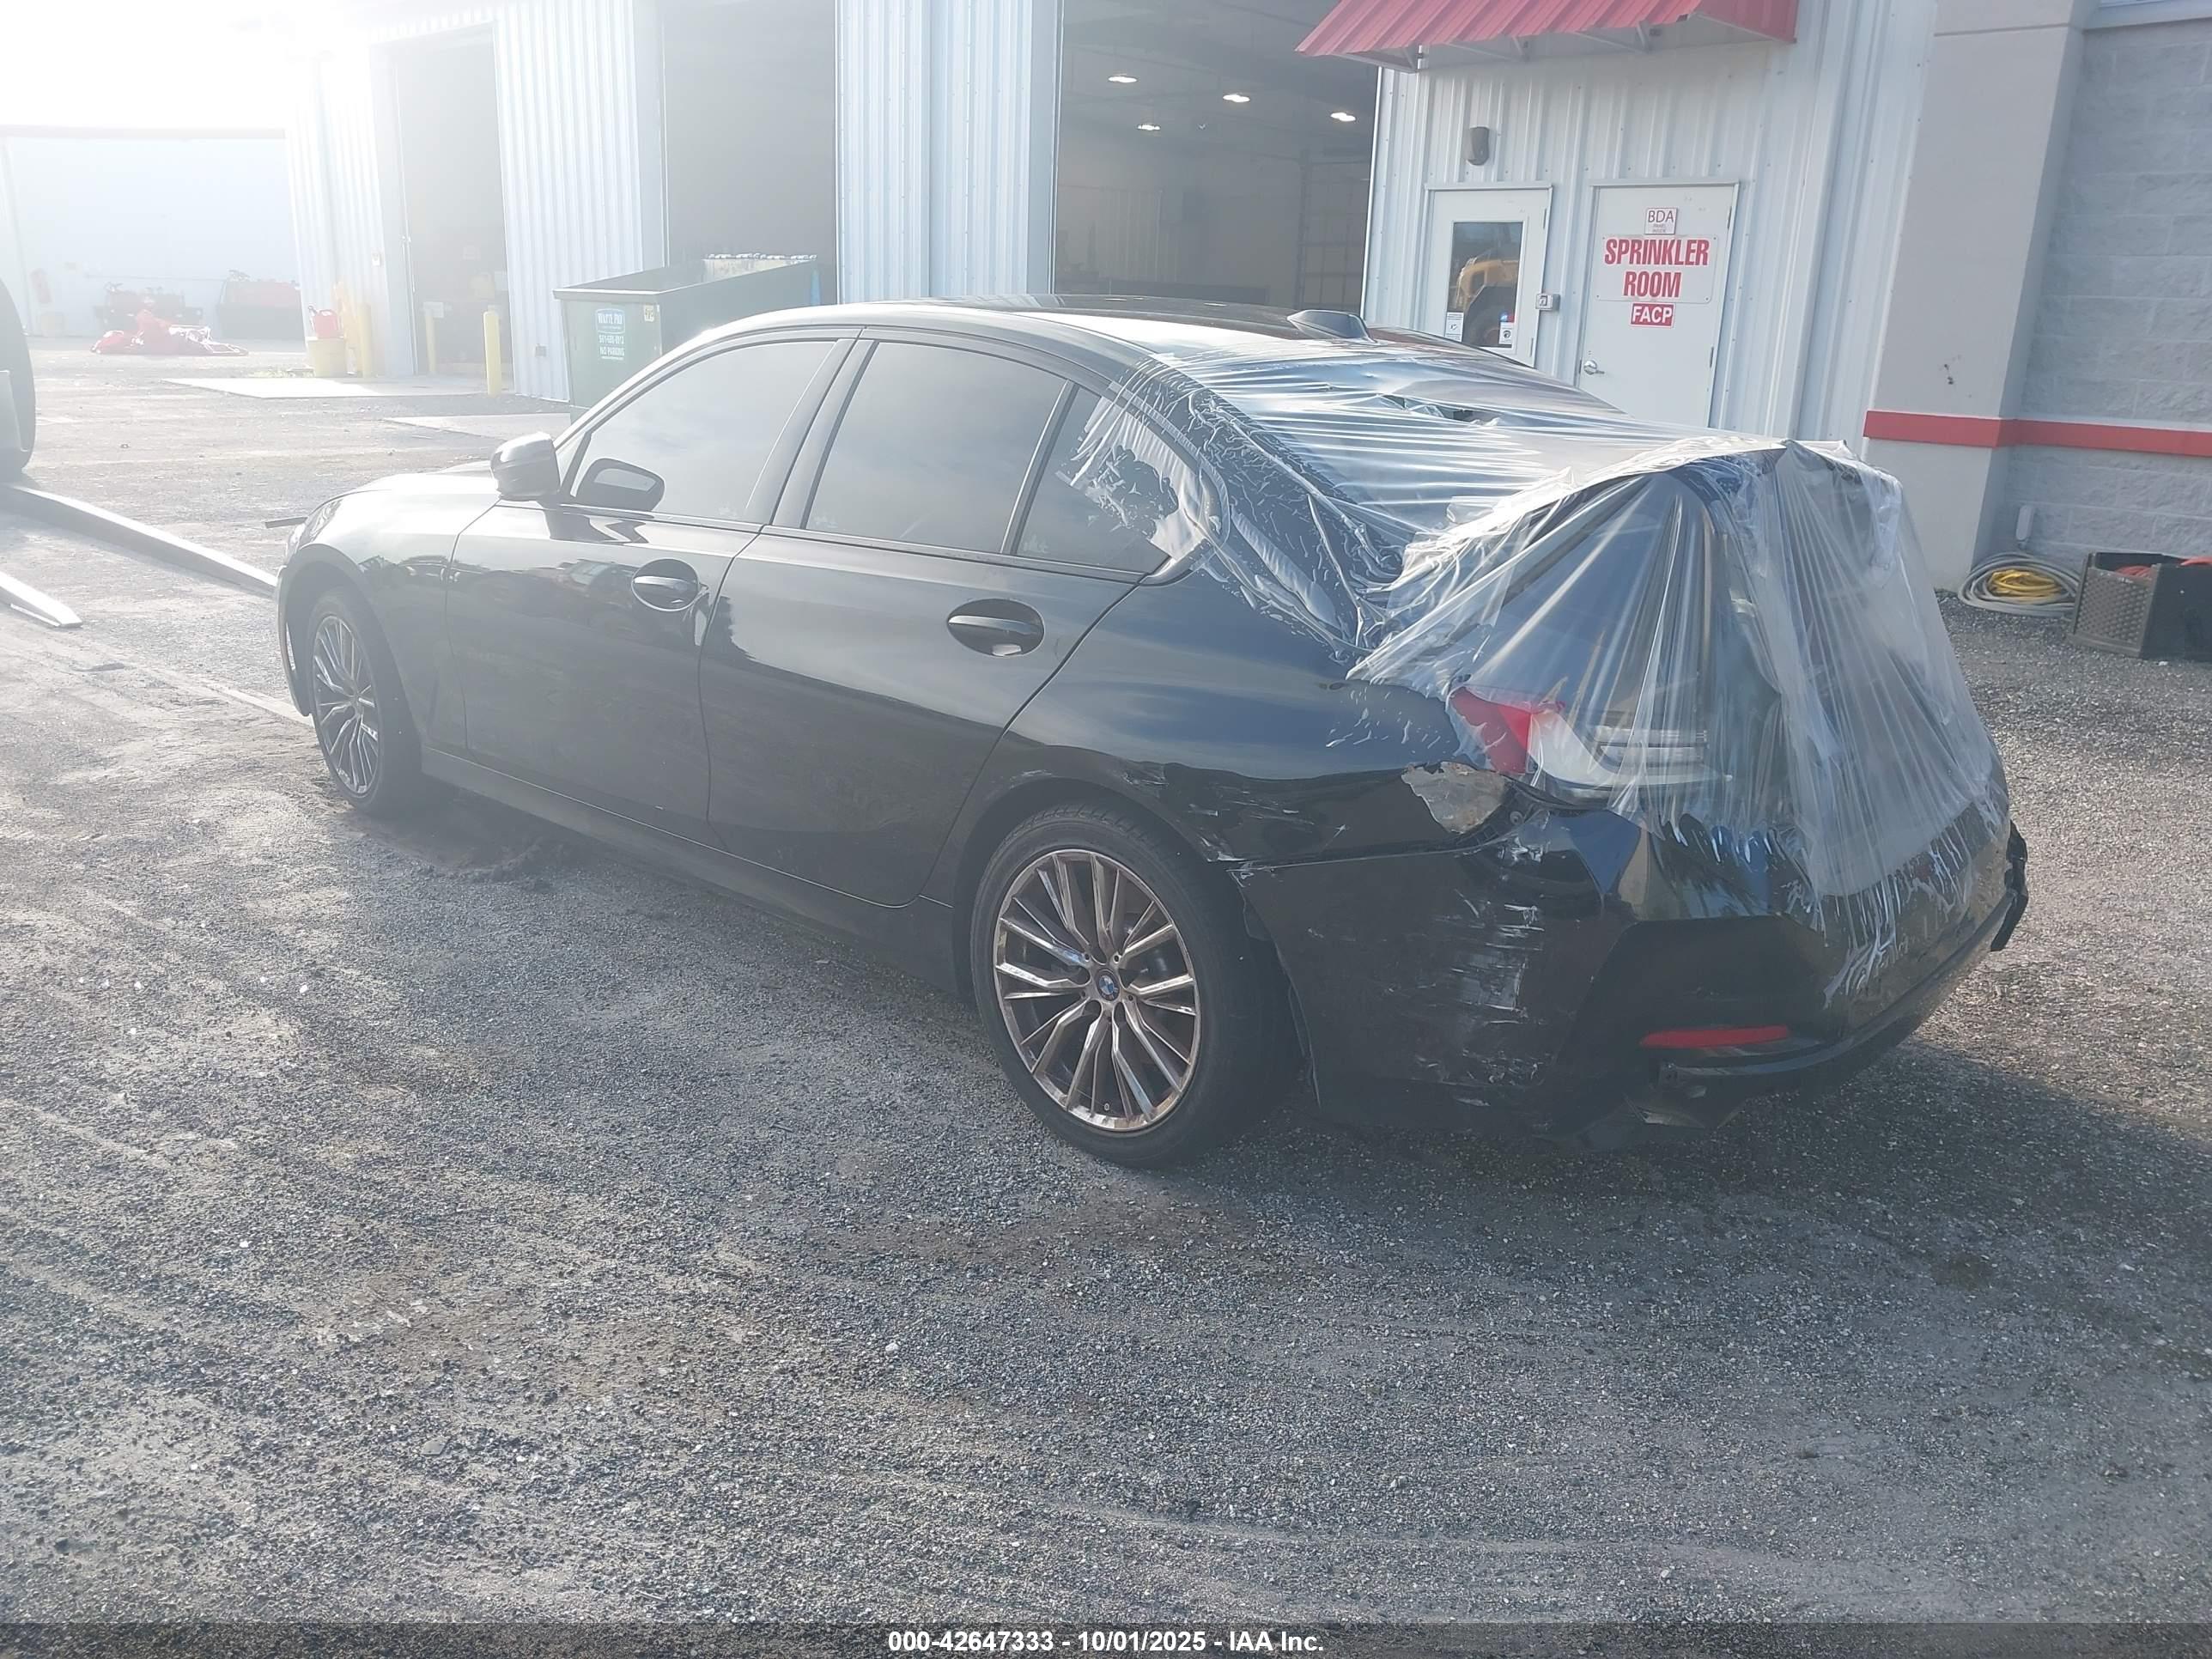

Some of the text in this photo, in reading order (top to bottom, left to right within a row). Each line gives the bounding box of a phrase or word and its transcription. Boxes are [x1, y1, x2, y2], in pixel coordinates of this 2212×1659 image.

[1648, 210, 1674, 223] BDA
[1604, 238, 1710, 265] SPRINKLER
[1623, 270, 1681, 297] ROOM
[1632, 306, 1673, 324] FACP
